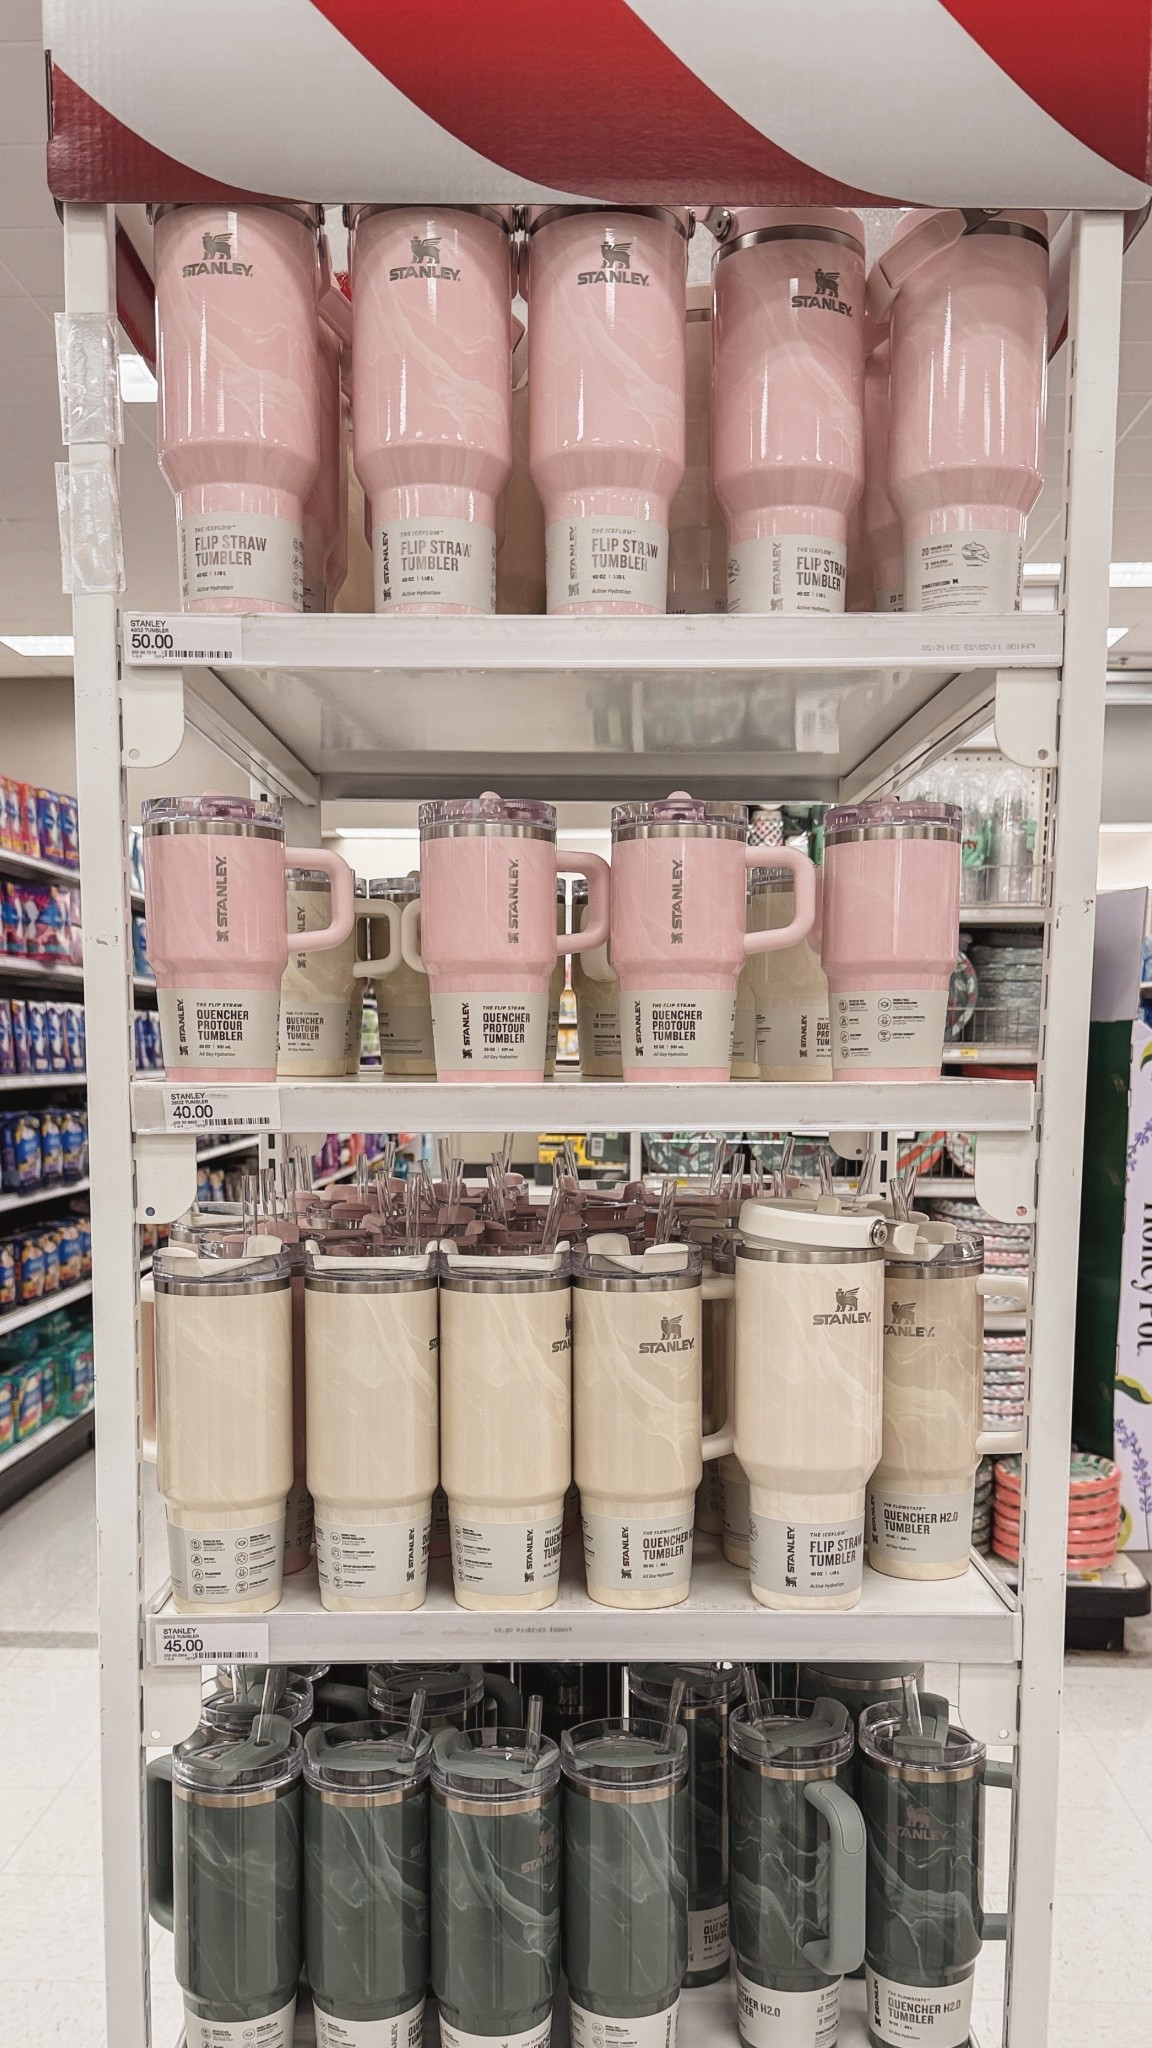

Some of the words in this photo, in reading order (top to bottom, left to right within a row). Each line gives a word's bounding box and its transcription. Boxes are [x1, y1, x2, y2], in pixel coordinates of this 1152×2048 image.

[183, 262, 253, 279] STANLEY
[389, 262, 460, 282] STANLEY
[577, 270, 649, 287] STANLEY
[791, 295, 852, 317] STANLEY
[195, 535, 219, 551] FLIP
[221, 535, 267, 552] STRAW
[401, 540, 426, 555] FLIP
[430, 540, 472, 558] STRAW
[592, 538, 619, 553] FLIP
[623, 538, 658, 559] STRAW
[195, 551, 252, 567] TUMBLER
[382, 531, 390, 584] STANLEY
[921, 548, 930, 557] 20
[401, 556, 459, 572] TUMBLER
[592, 554, 648, 572] TUMBLER
[772, 542, 781, 596] STANLEY
[796, 556, 821, 571] FLIP
[924, 562, 929, 571] 3
[210, 584, 233, 592] Hydration
[796, 572, 841, 593] TUMBLER
[131, 634, 173, 649] 50.00
[216, 856, 228, 927] STANLEY
[508, 858, 519, 929] STANLEY
[671, 859, 683, 929] STANLEY
[177, 999, 186, 1042] STANLEY
[196, 1009, 249, 1020] QUENCHER
[286, 1016, 324, 1025] QUENCHER
[483, 1013, 530, 1023] QUENCHER
[652, 1010, 702, 1020] QUENCHER
[197, 1020, 243, 1031] PROTOUR
[286, 1024, 319, 1032] PROTOUR
[461, 1002, 470, 1046] STANLEY
[483, 1023, 525, 1033] PROTOUR
[652, 1020, 696, 1031] PROTOUR
[800, 1014, 808, 1048] STANLEY
[198, 1031, 243, 1041] TUMBLER
[287, 1032, 320, 1040] TUMBLER
[483, 1034, 525, 1044] TUMBLER
[652, 1031, 696, 1041] TUMBLER
[171, 1092, 205, 1100] STANLEY
[173, 1105, 213, 1119] 40.00
[812, 1312, 871, 1326] STANLEY
[638, 1338, 695, 1354] STANLEY
[884, 1509, 937, 1523] QUENCHER
[940, 1511, 958, 1523] H2.0
[884, 1520, 930, 1534] TUMBLER
[621, 1526, 629, 1567] STANLEY
[643, 1532, 688, 1549] QUENCHER
[810, 1541, 834, 1553] FLIP
[526, 1529, 534, 1570] STANLEY
[643, 1544, 684, 1560] TUMBLER
[787, 1526, 795, 1573] STANLEY
[810, 1550, 856, 1567] TUMBLER
[164, 1639, 203, 1652] 45.00
[703, 1918, 728, 1935] QUENC
[761, 2003, 781, 2017] H2.0
[888, 1997, 941, 2014] QUENCHER
[943, 2000, 961, 2013] H2.0
[888, 2008, 934, 2025] TUMBLER
